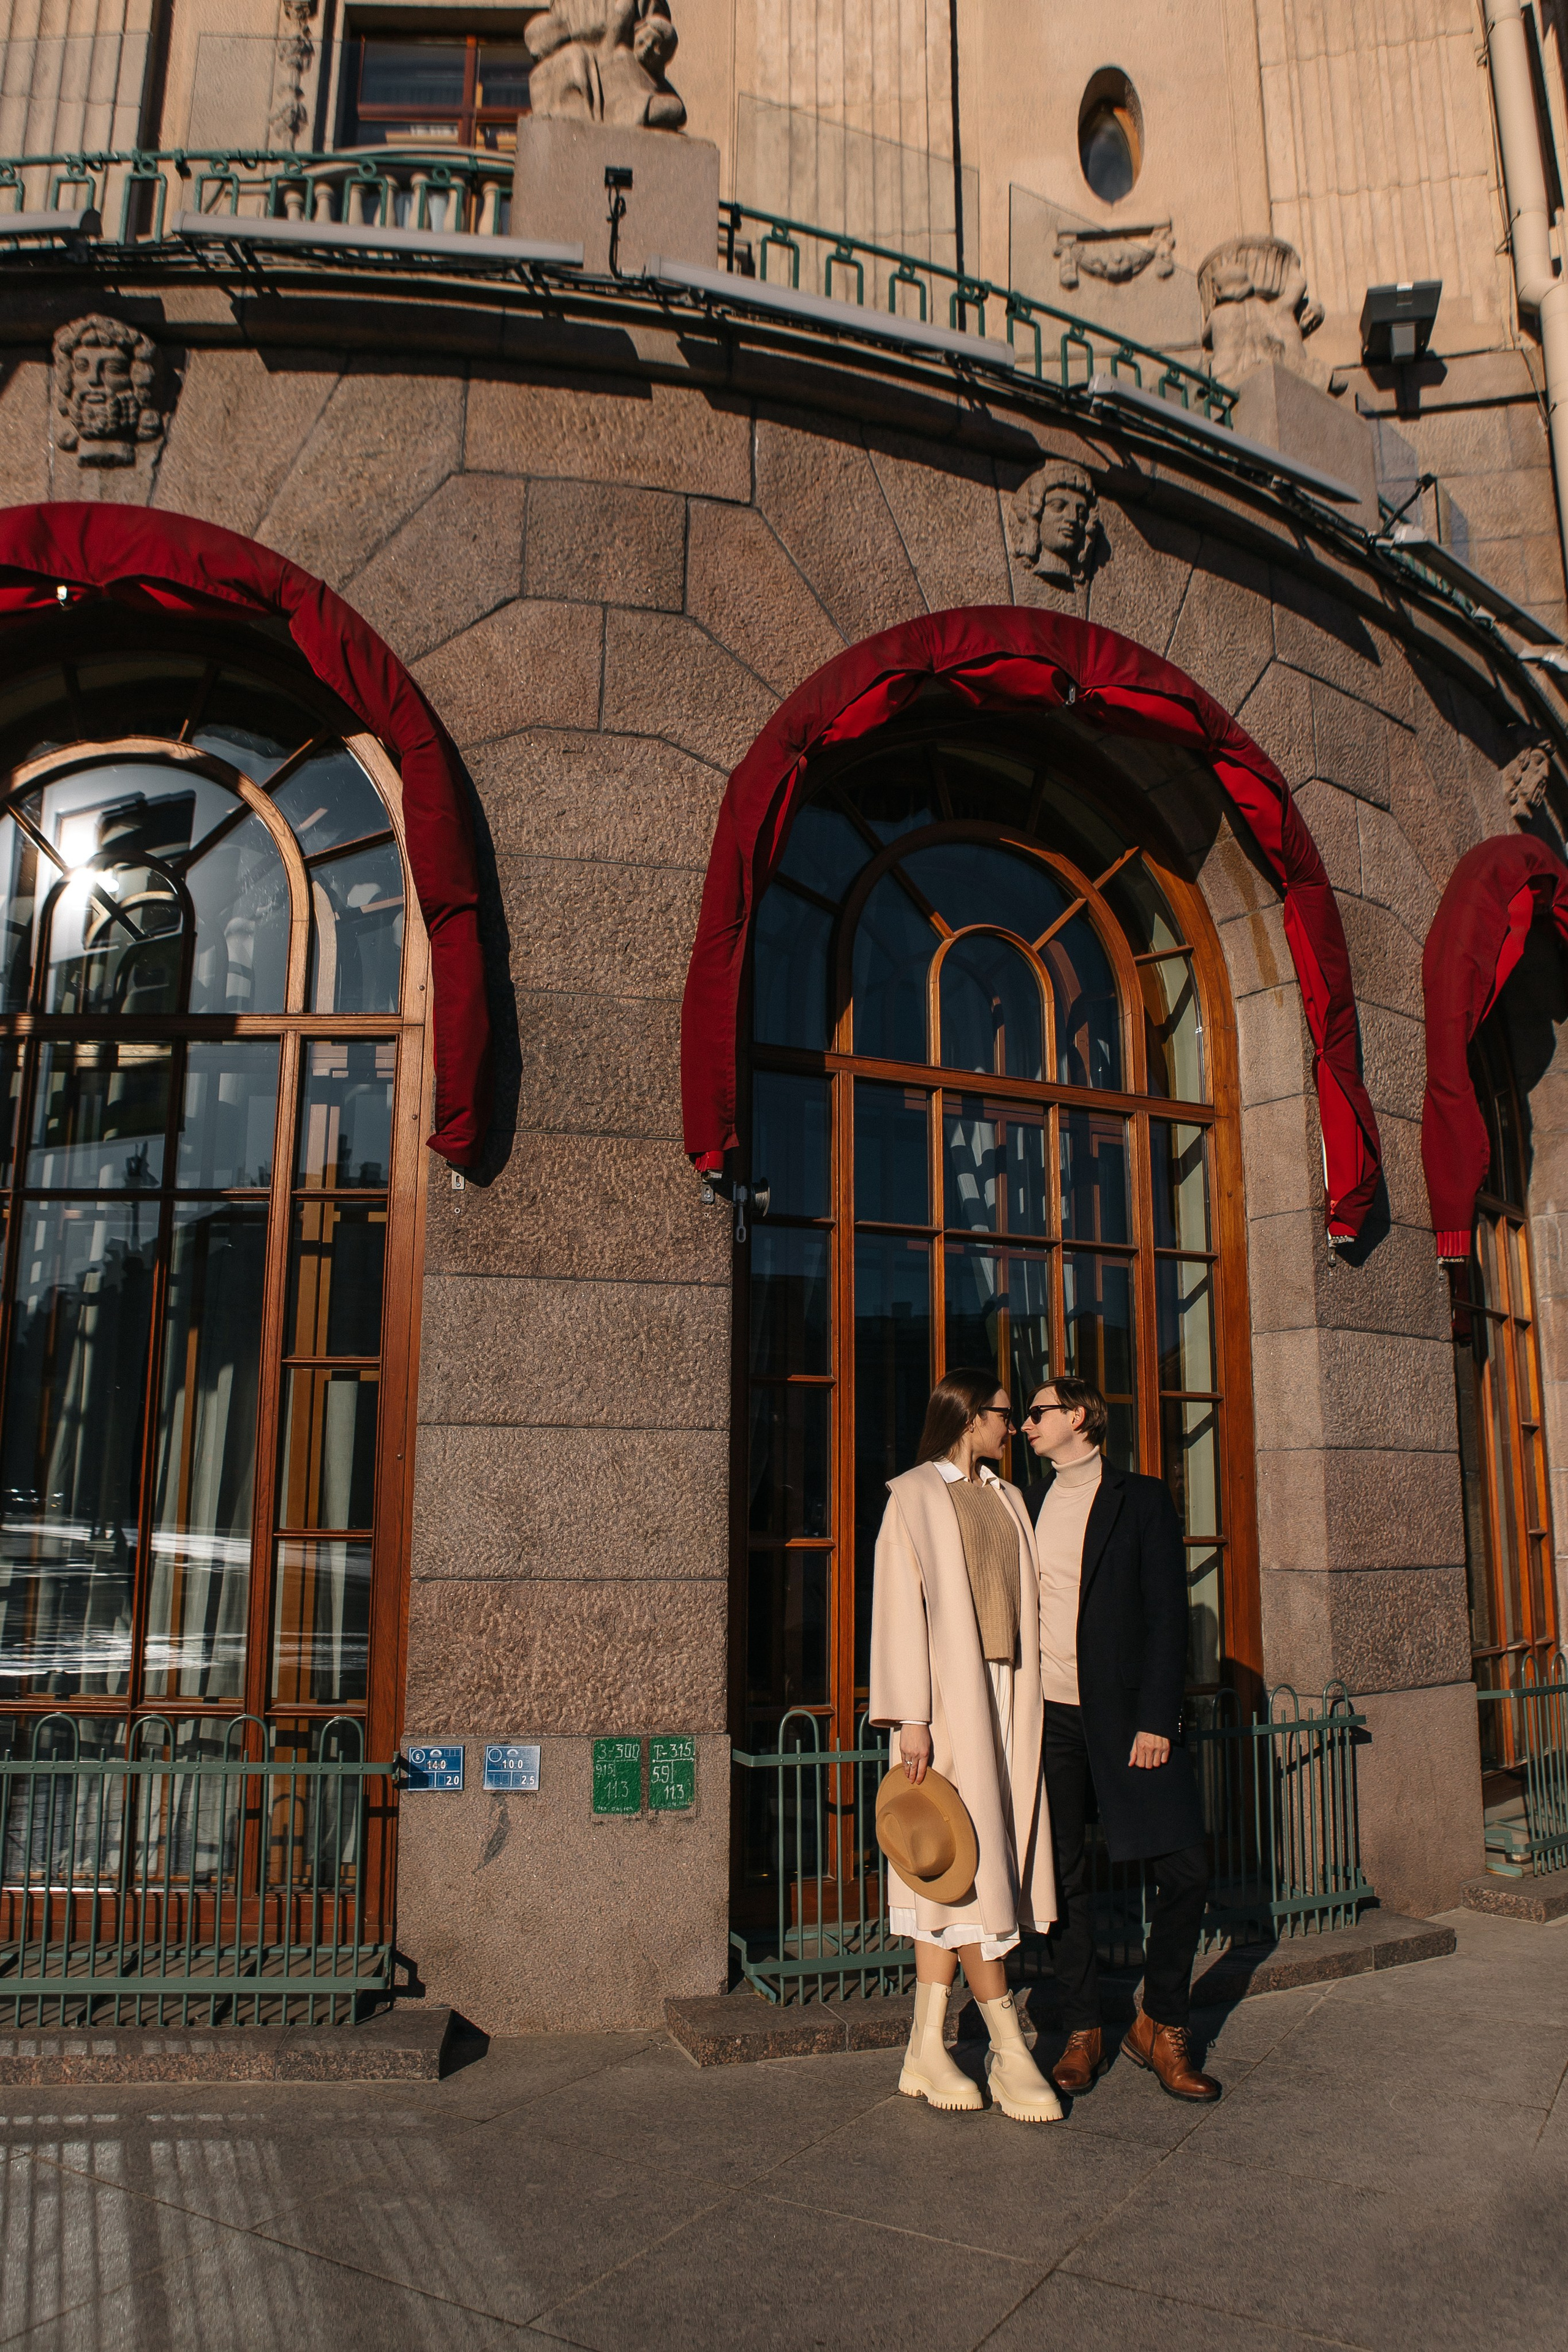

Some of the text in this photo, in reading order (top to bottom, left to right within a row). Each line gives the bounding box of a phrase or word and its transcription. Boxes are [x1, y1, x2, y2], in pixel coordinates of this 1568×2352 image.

[427, 1760, 446, 1770] 14.0
[502, 1760, 523, 1769] 10.0
[447, 1776, 459, 1785] 2.0
[521, 1775, 535, 1785] 2.5
